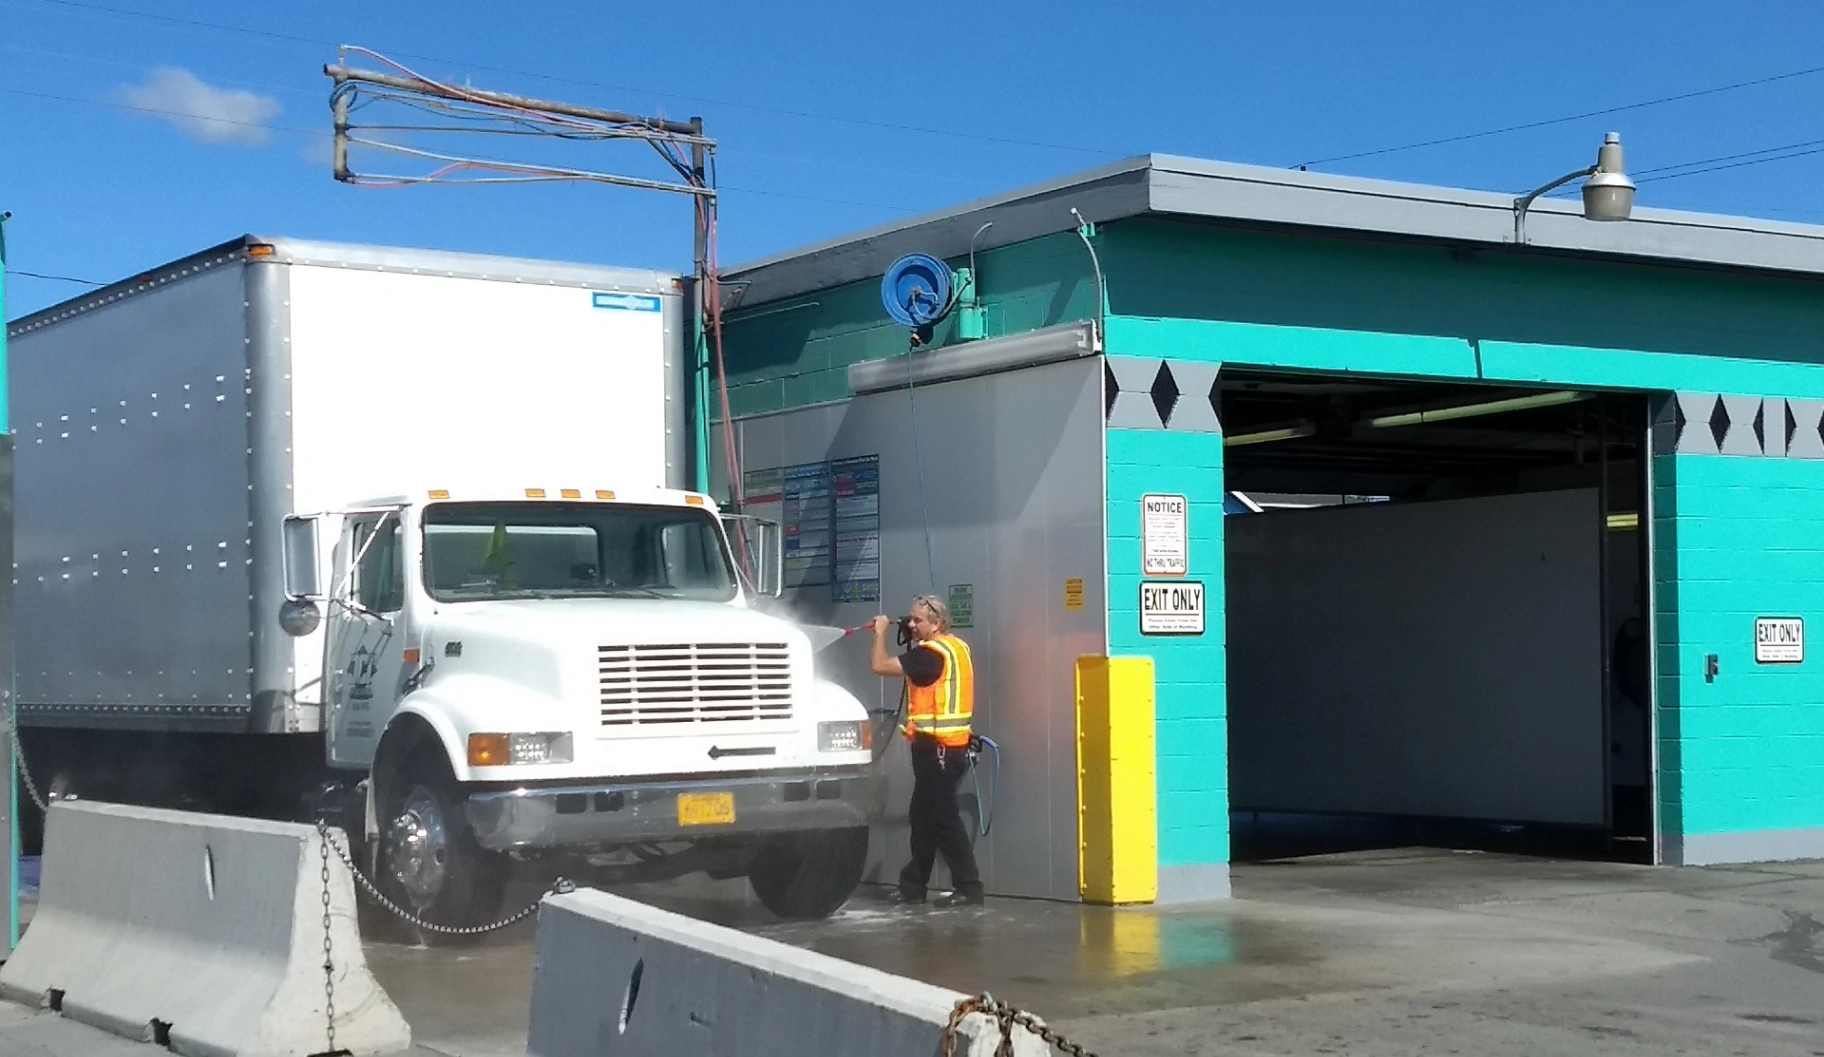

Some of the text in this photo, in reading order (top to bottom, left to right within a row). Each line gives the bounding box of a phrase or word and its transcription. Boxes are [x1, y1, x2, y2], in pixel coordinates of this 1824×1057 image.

[1147, 502, 1182, 513] NOTICE
[1147, 558, 1184, 568] NO THRU TRAFFIC
[1144, 588, 1200, 610] EXIT ONLY
[1759, 623, 1800, 642] EXIT ONLY
